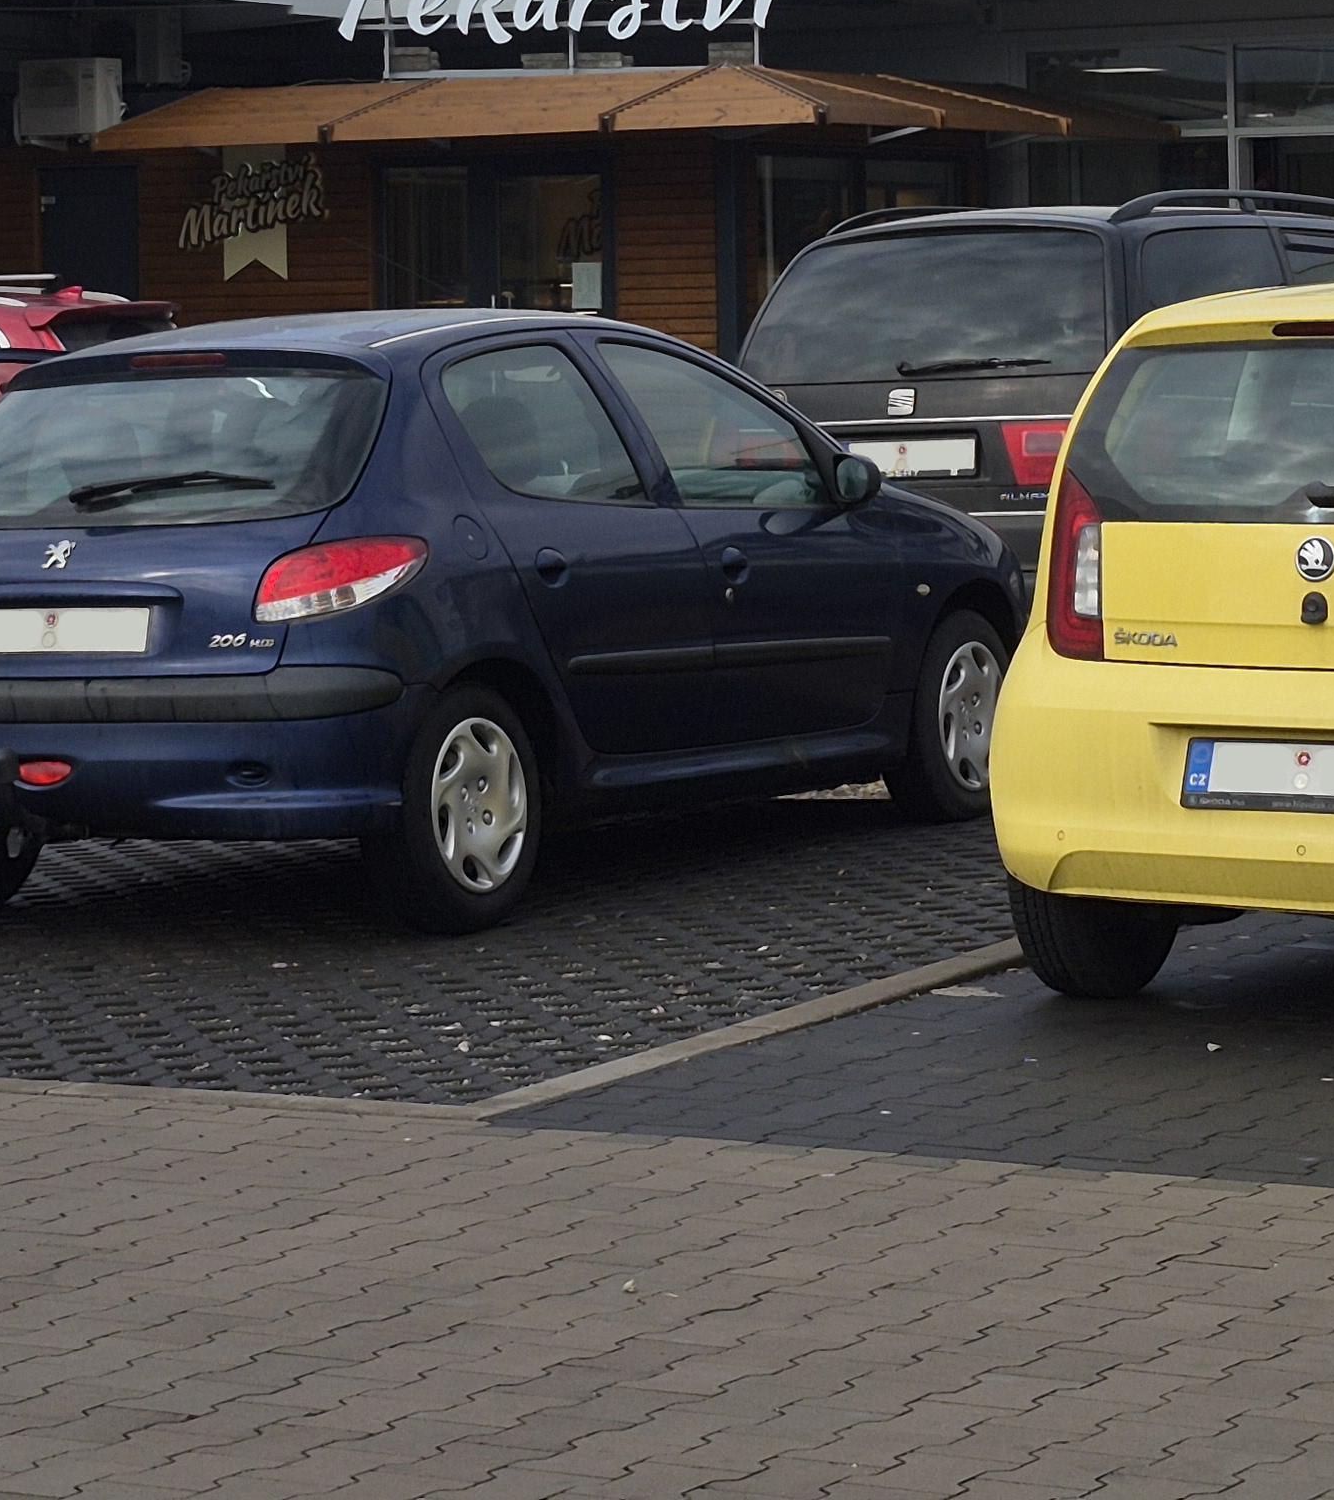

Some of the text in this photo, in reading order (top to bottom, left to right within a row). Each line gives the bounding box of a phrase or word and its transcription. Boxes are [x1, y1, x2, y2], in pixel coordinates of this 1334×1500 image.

[208, 632, 247, 648] 206
[1113, 627, 1178, 647] ŠKODA
[1189, 773, 1207, 786] CZ
